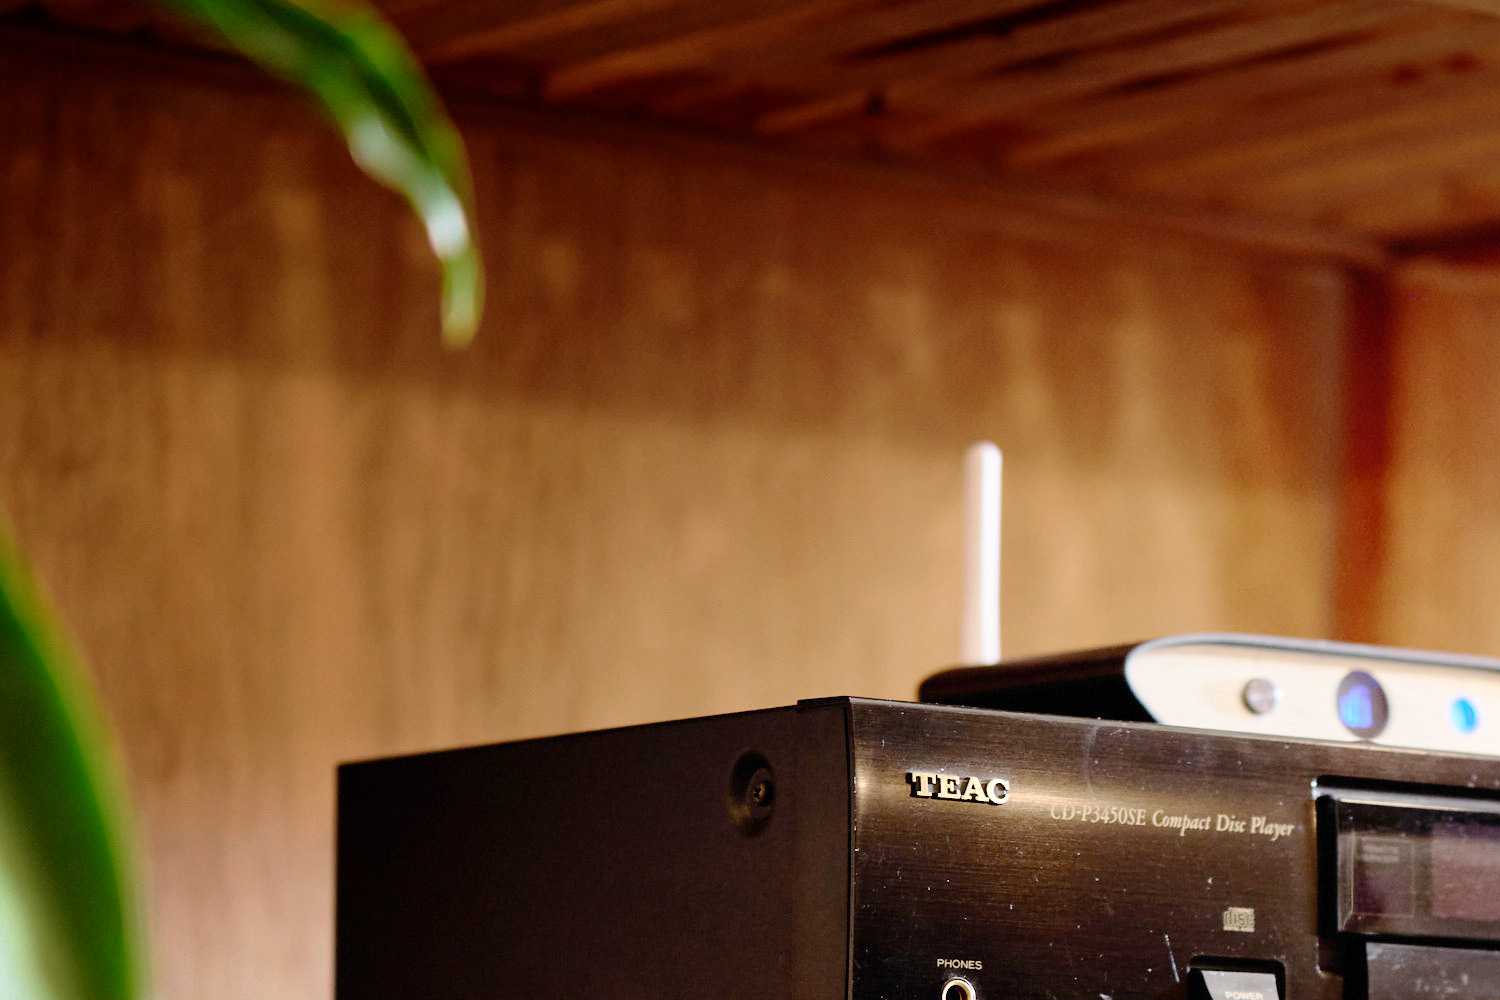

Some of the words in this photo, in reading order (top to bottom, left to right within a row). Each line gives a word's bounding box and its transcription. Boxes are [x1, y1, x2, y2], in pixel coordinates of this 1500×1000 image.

[908, 773, 1010, 804] TEAC
[1050, 805, 1147, 826] CD-P3450SE
[1152, 810, 1212, 837] Compact
[1216, 814, 1247, 834] Disc
[1250, 816, 1296, 841] Player
[937, 958, 983, 970] PHONES
[1225, 991, 1264, 1000] POWER
